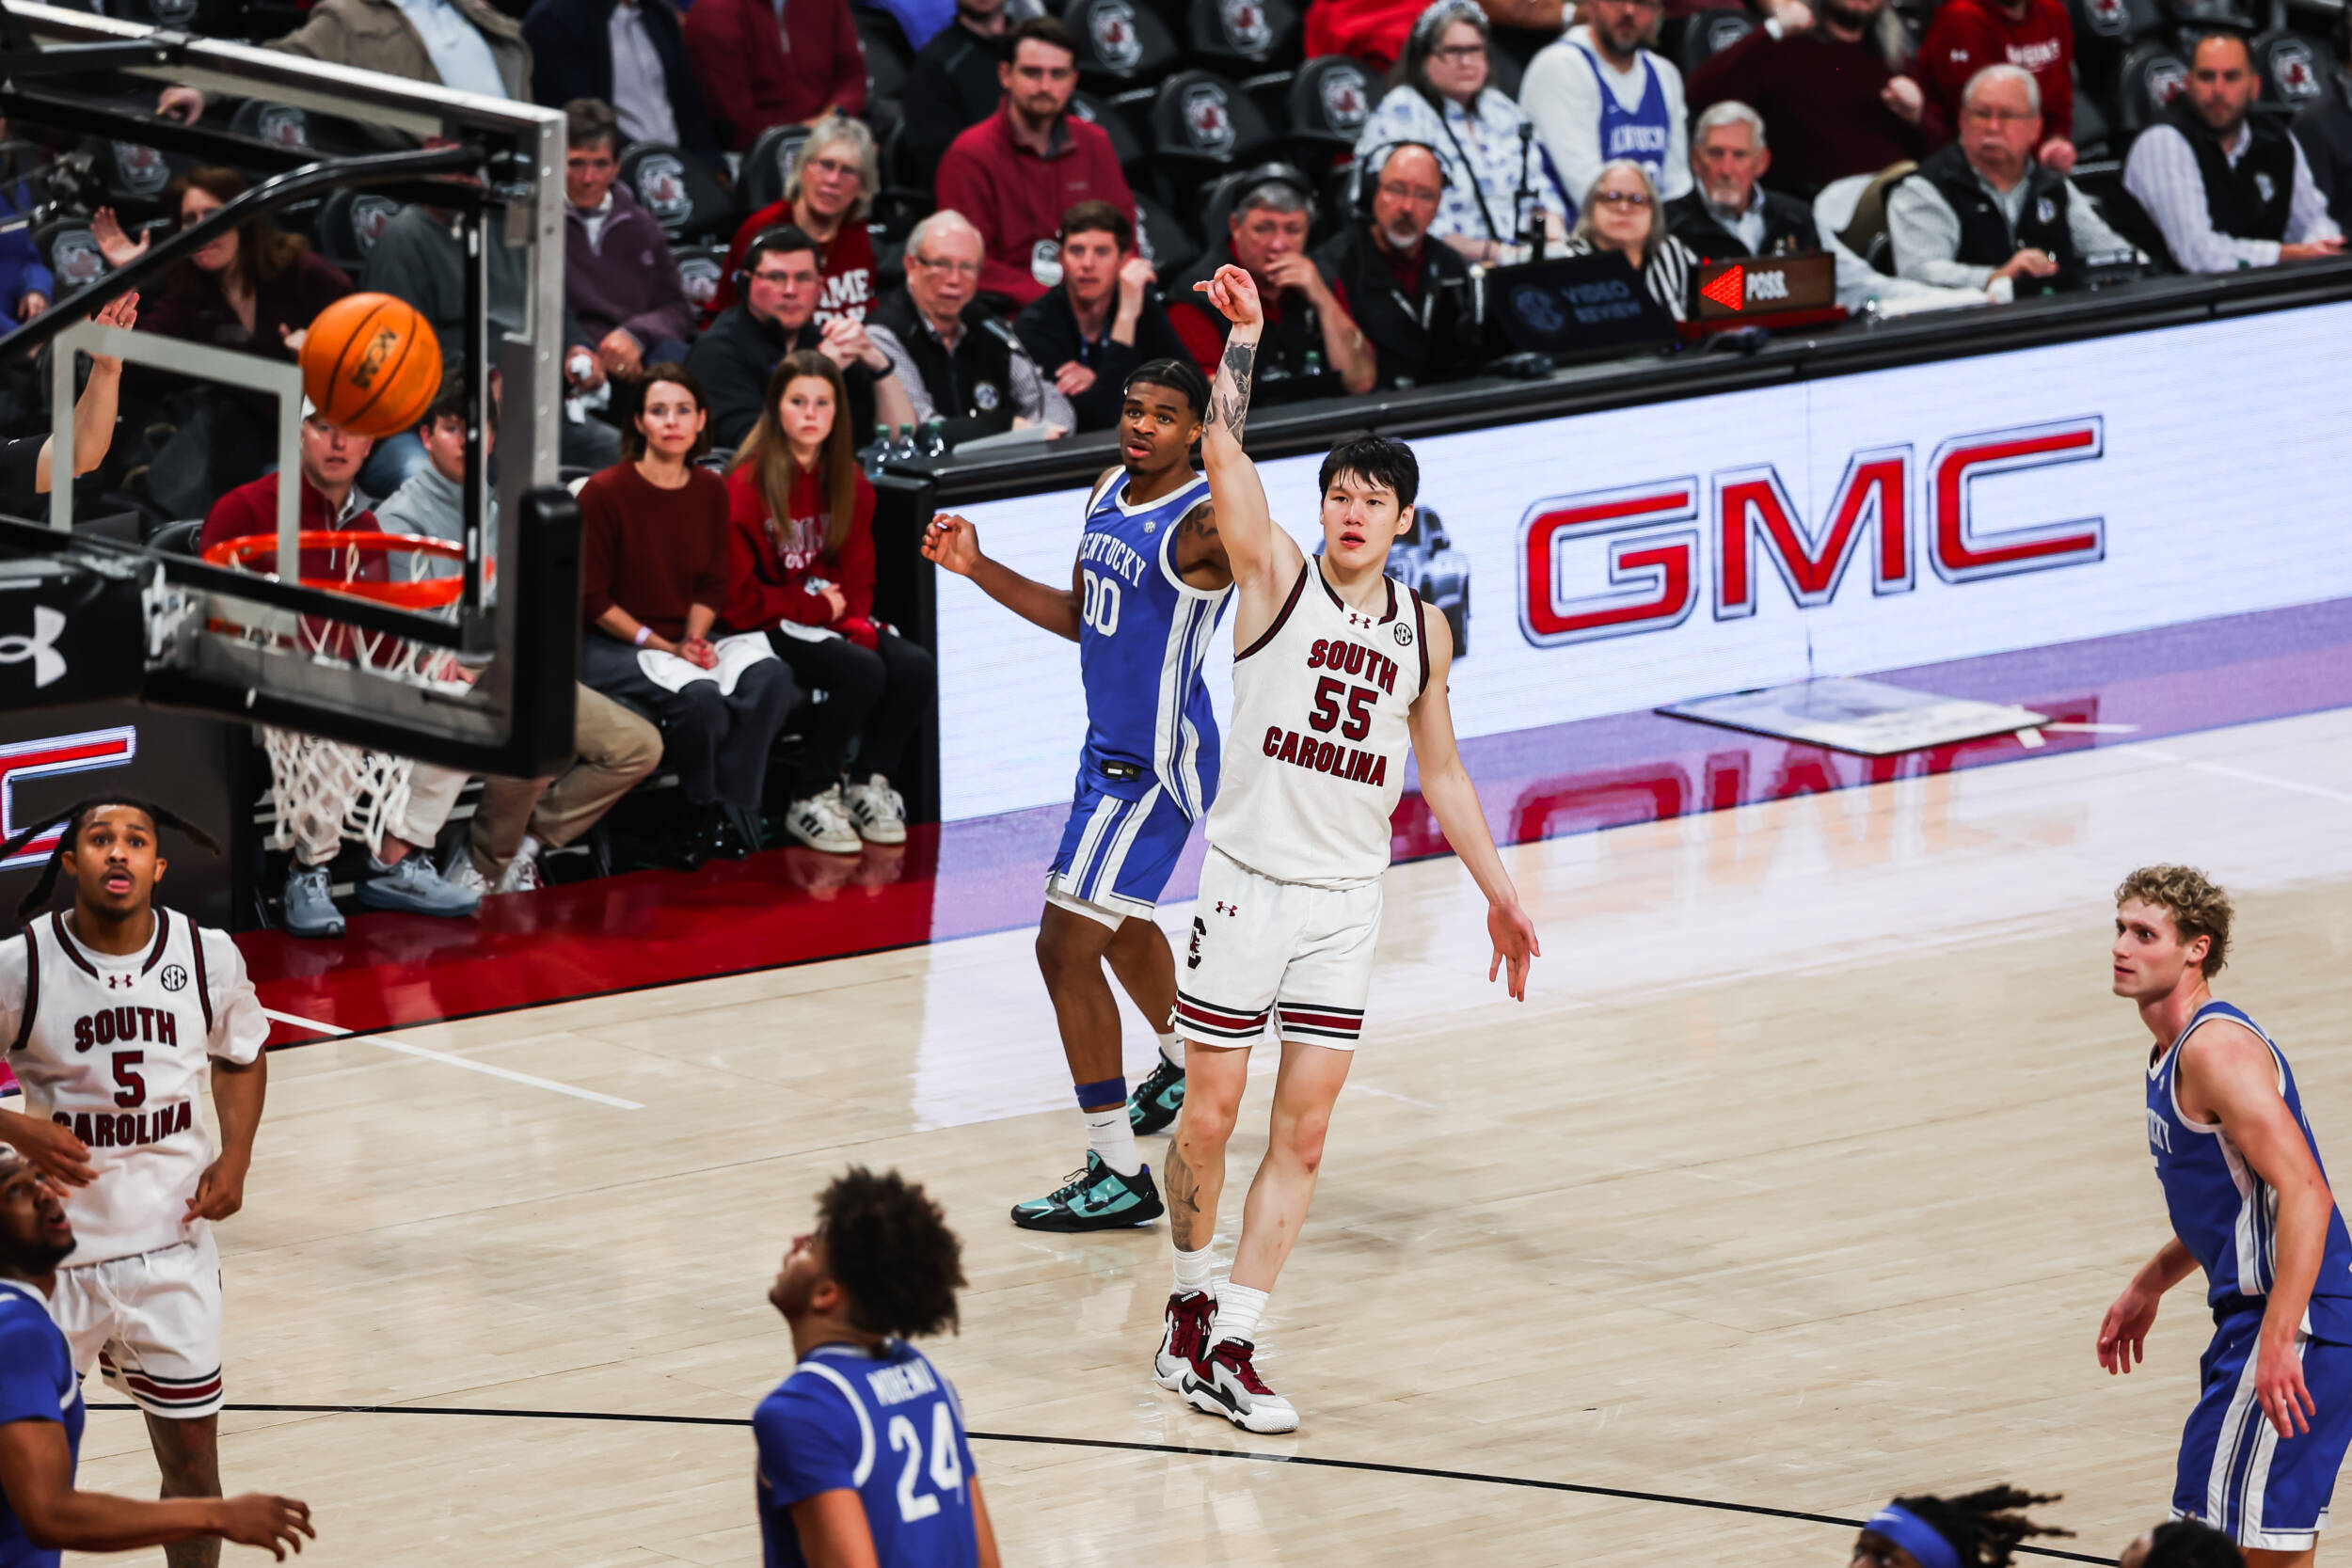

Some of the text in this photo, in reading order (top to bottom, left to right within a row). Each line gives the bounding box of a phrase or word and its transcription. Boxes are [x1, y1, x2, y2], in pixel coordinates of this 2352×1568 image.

[1560, 280, 1630, 305] VIDEO
[1574, 300, 1641, 324] REVIEW
[1517, 414, 2106, 649] GMC
[1083, 568, 1121, 637] 00
[1395, 625, 1413, 645] SEC
[1307, 639, 1399, 697] SOUTH
[1309, 674, 1379, 742] 55
[1263, 725, 1388, 787] CAROLINA
[163, 966, 187, 990] SEC
[74, 1006, 177, 1053] SOUTH
[111, 1050, 147, 1108] 5
[888, 1401, 964, 1524] 24
